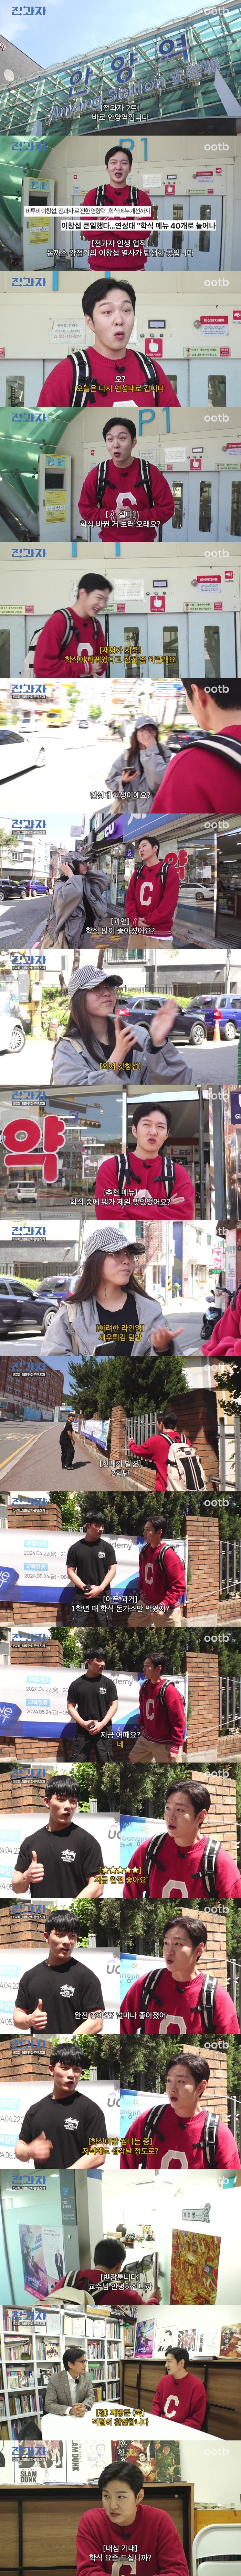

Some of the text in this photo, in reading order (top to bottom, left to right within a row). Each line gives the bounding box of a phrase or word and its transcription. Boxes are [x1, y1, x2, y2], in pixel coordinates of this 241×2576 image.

[68, 34, 191, 99] 안양역
[49, 76, 166, 120] Anyang Station
[139, 407, 170, 435] P1
[104, 822, 115, 838] CU
[139, 882, 153, 906] C
[1, 1114, 66, 1184] 약
[112, 1542, 132, 1550] demy
[145, 1562, 154, 1585] C
[114, 1678, 133, 1686] demy
[146, 1698, 154, 1720] C
[164, 2395, 179, 2418] C
